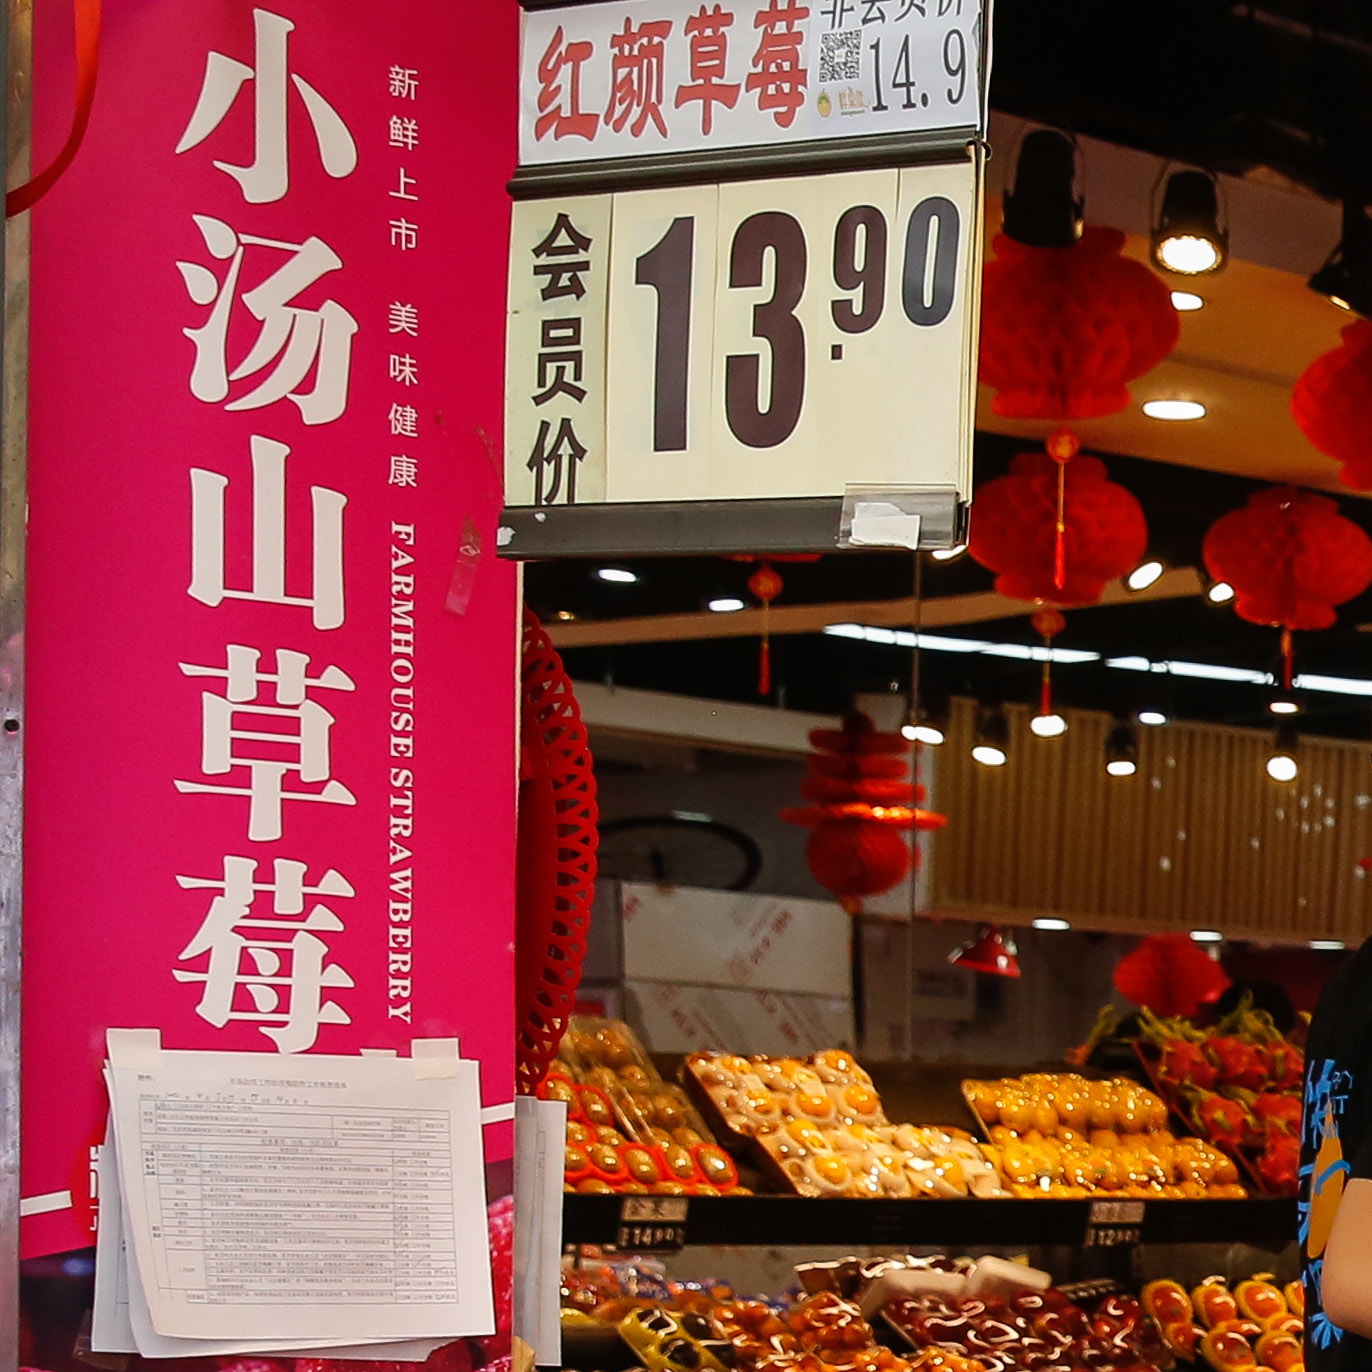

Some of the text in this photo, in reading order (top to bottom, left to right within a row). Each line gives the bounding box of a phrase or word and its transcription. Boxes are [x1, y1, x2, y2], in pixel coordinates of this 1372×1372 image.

[534, 2, 810, 142] 红颜草莓
[869, 28, 967, 113] 14.9
[388, 66, 420, 488] 新鲜上市 美味健康
[527, 211, 592, 506] 会员价
[634, 195, 961, 453] 13.90
[172, 8, 360, 1053] 小汤山草莓
[387, 521, 414, 1024] FARMHOUSE STRAWBERRY
